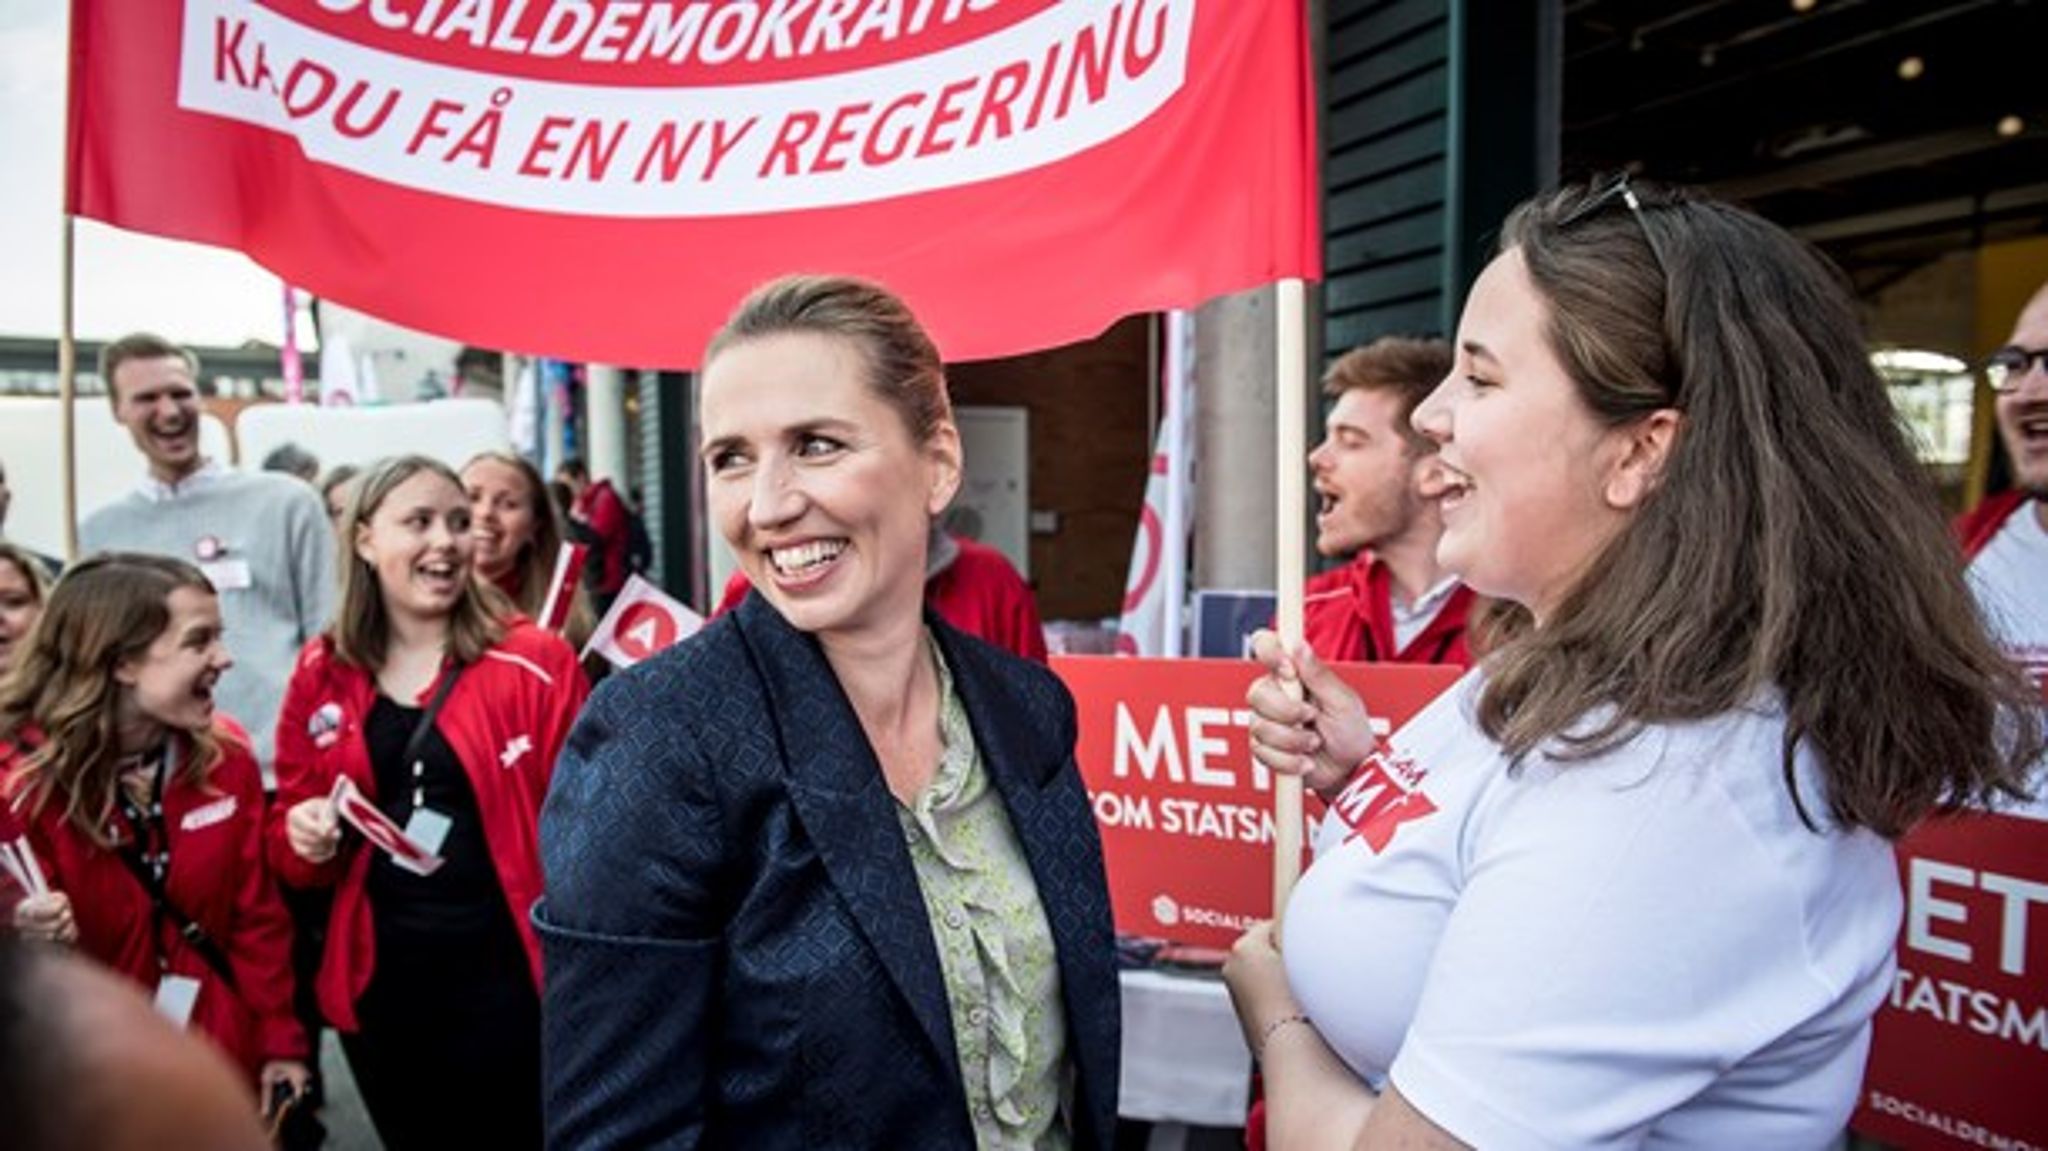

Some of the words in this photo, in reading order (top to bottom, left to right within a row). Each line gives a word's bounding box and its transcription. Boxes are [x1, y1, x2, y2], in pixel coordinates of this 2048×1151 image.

[283, 58, 401, 138] DU
[405, 86, 513, 169] FÅ
[518, 117, 627, 181] EN
[634, 114, 758, 182] NY
[758, 0, 1168, 178] REGERING
